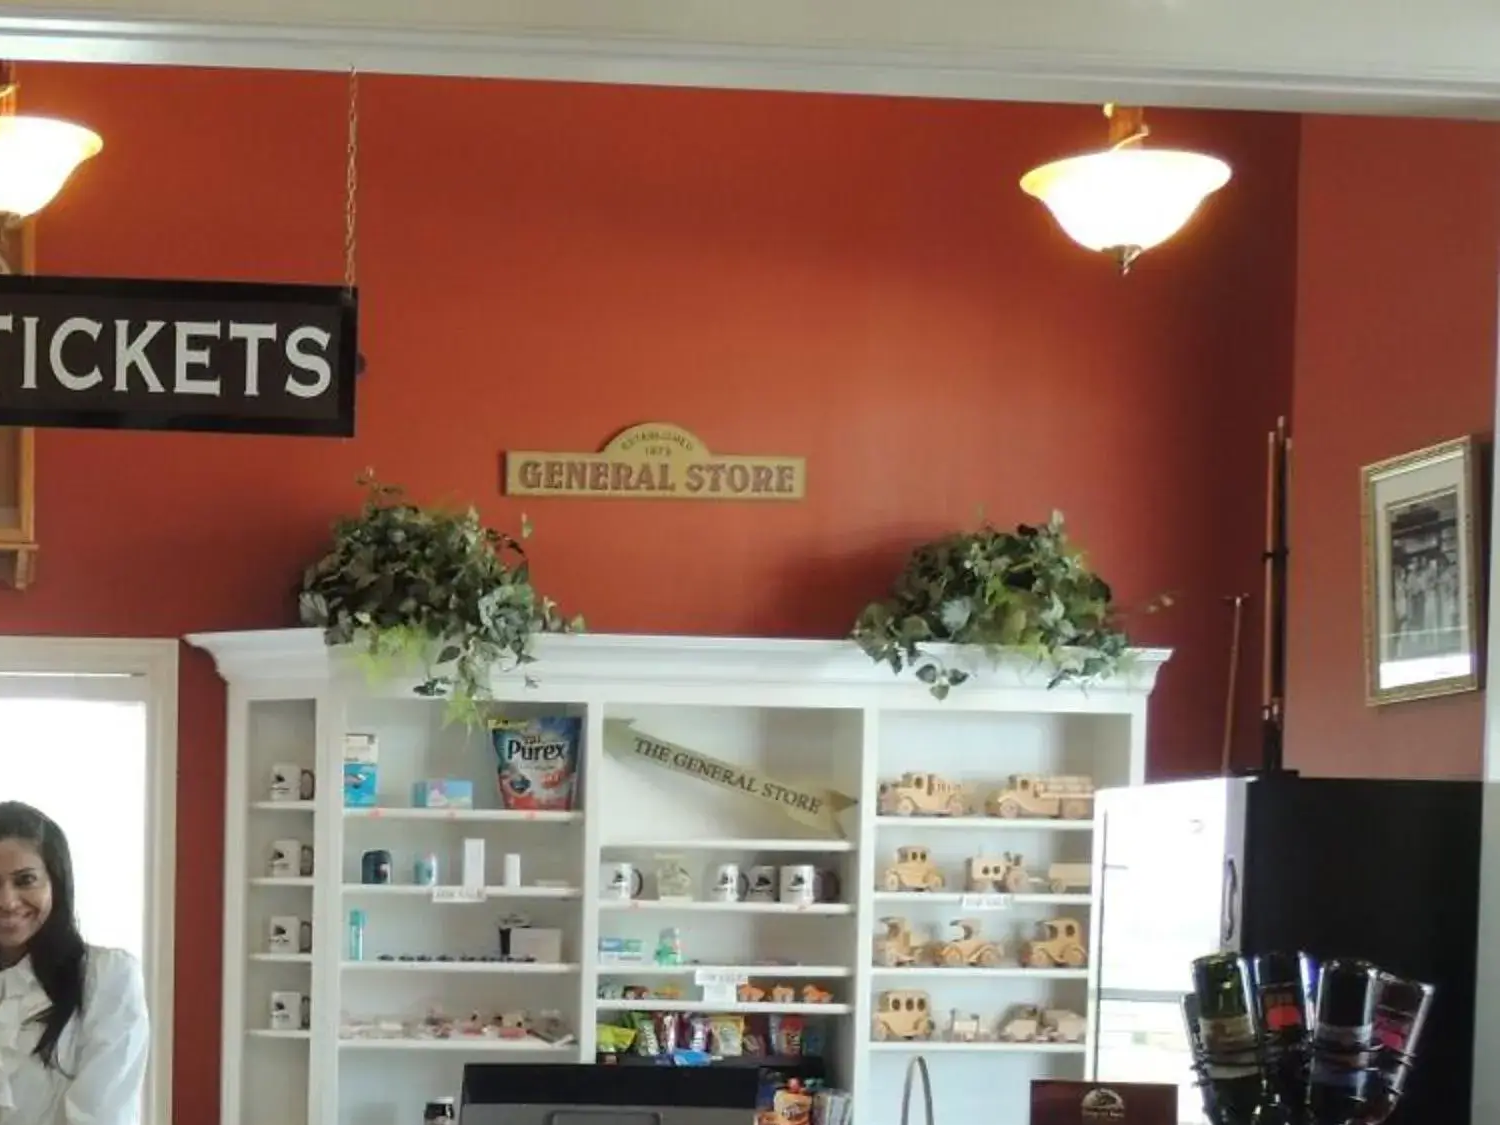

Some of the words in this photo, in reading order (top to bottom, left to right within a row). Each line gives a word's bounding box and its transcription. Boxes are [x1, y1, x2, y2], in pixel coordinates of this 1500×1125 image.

[518, 461, 676, 492] GENERAL
[684, 464, 795, 494] STORE
[507, 739, 565, 760] Purex
[634, 737, 669, 763] THE
[673, 753, 758, 793] GENERAL
[761, 783, 823, 814] STORE
